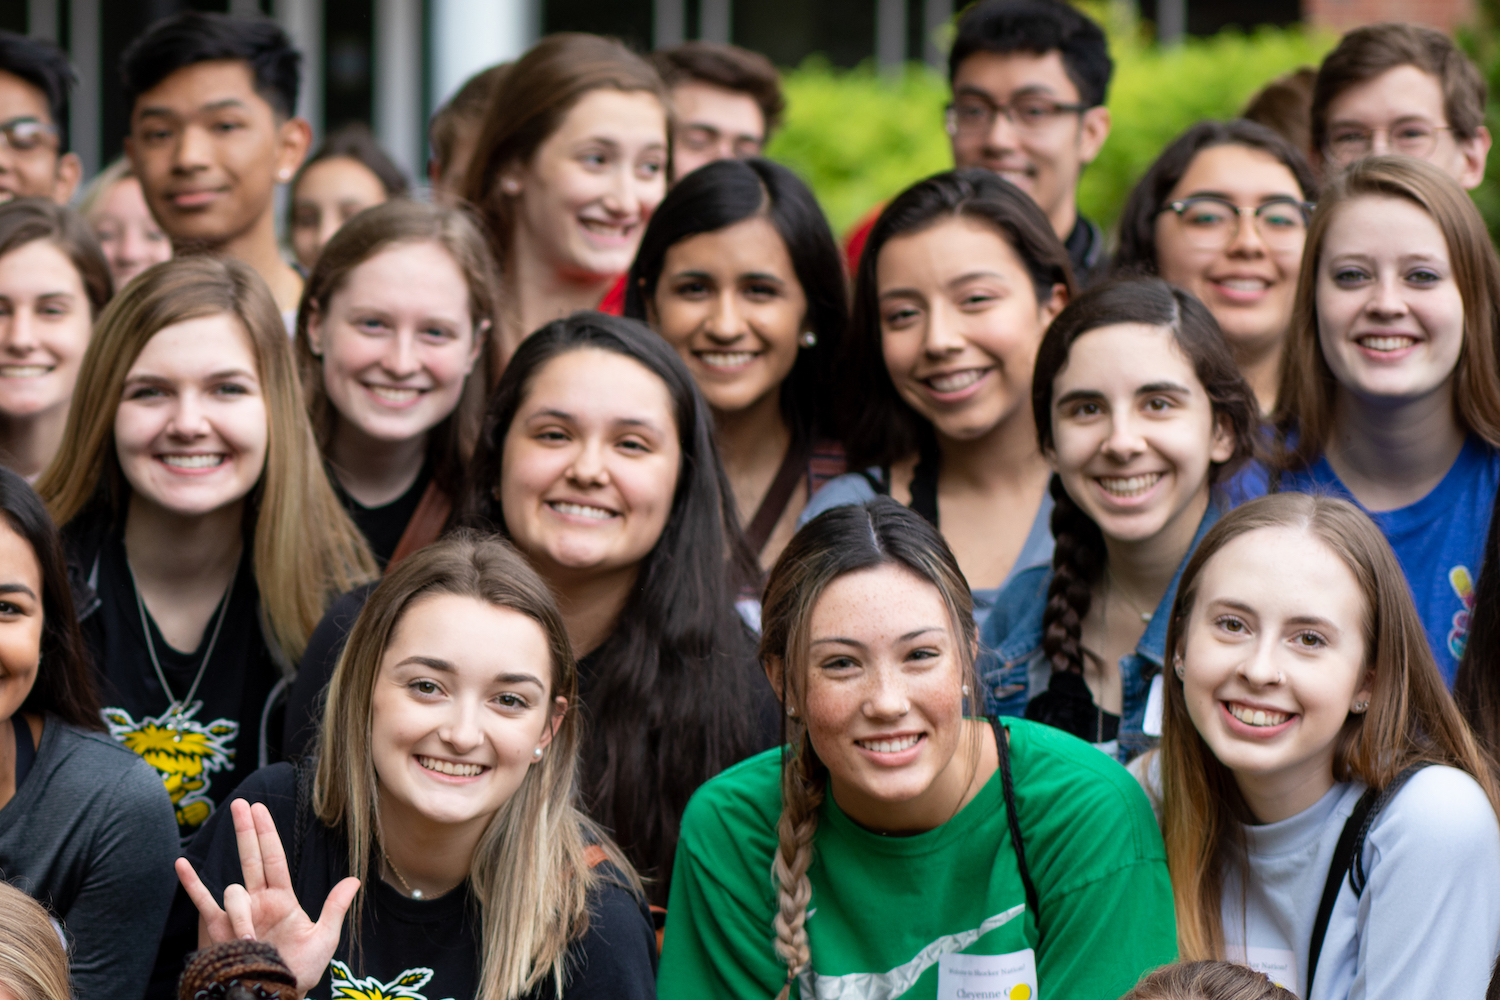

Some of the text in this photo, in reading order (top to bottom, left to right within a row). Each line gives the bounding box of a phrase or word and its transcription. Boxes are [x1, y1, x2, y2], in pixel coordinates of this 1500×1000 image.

[974, 968, 999, 976] Shocker
[1001, 963, 1025, 975] Nation!
[1261, 962, 1288, 971] Nation!
[956, 987, 1000, 1000] Cheyenne
